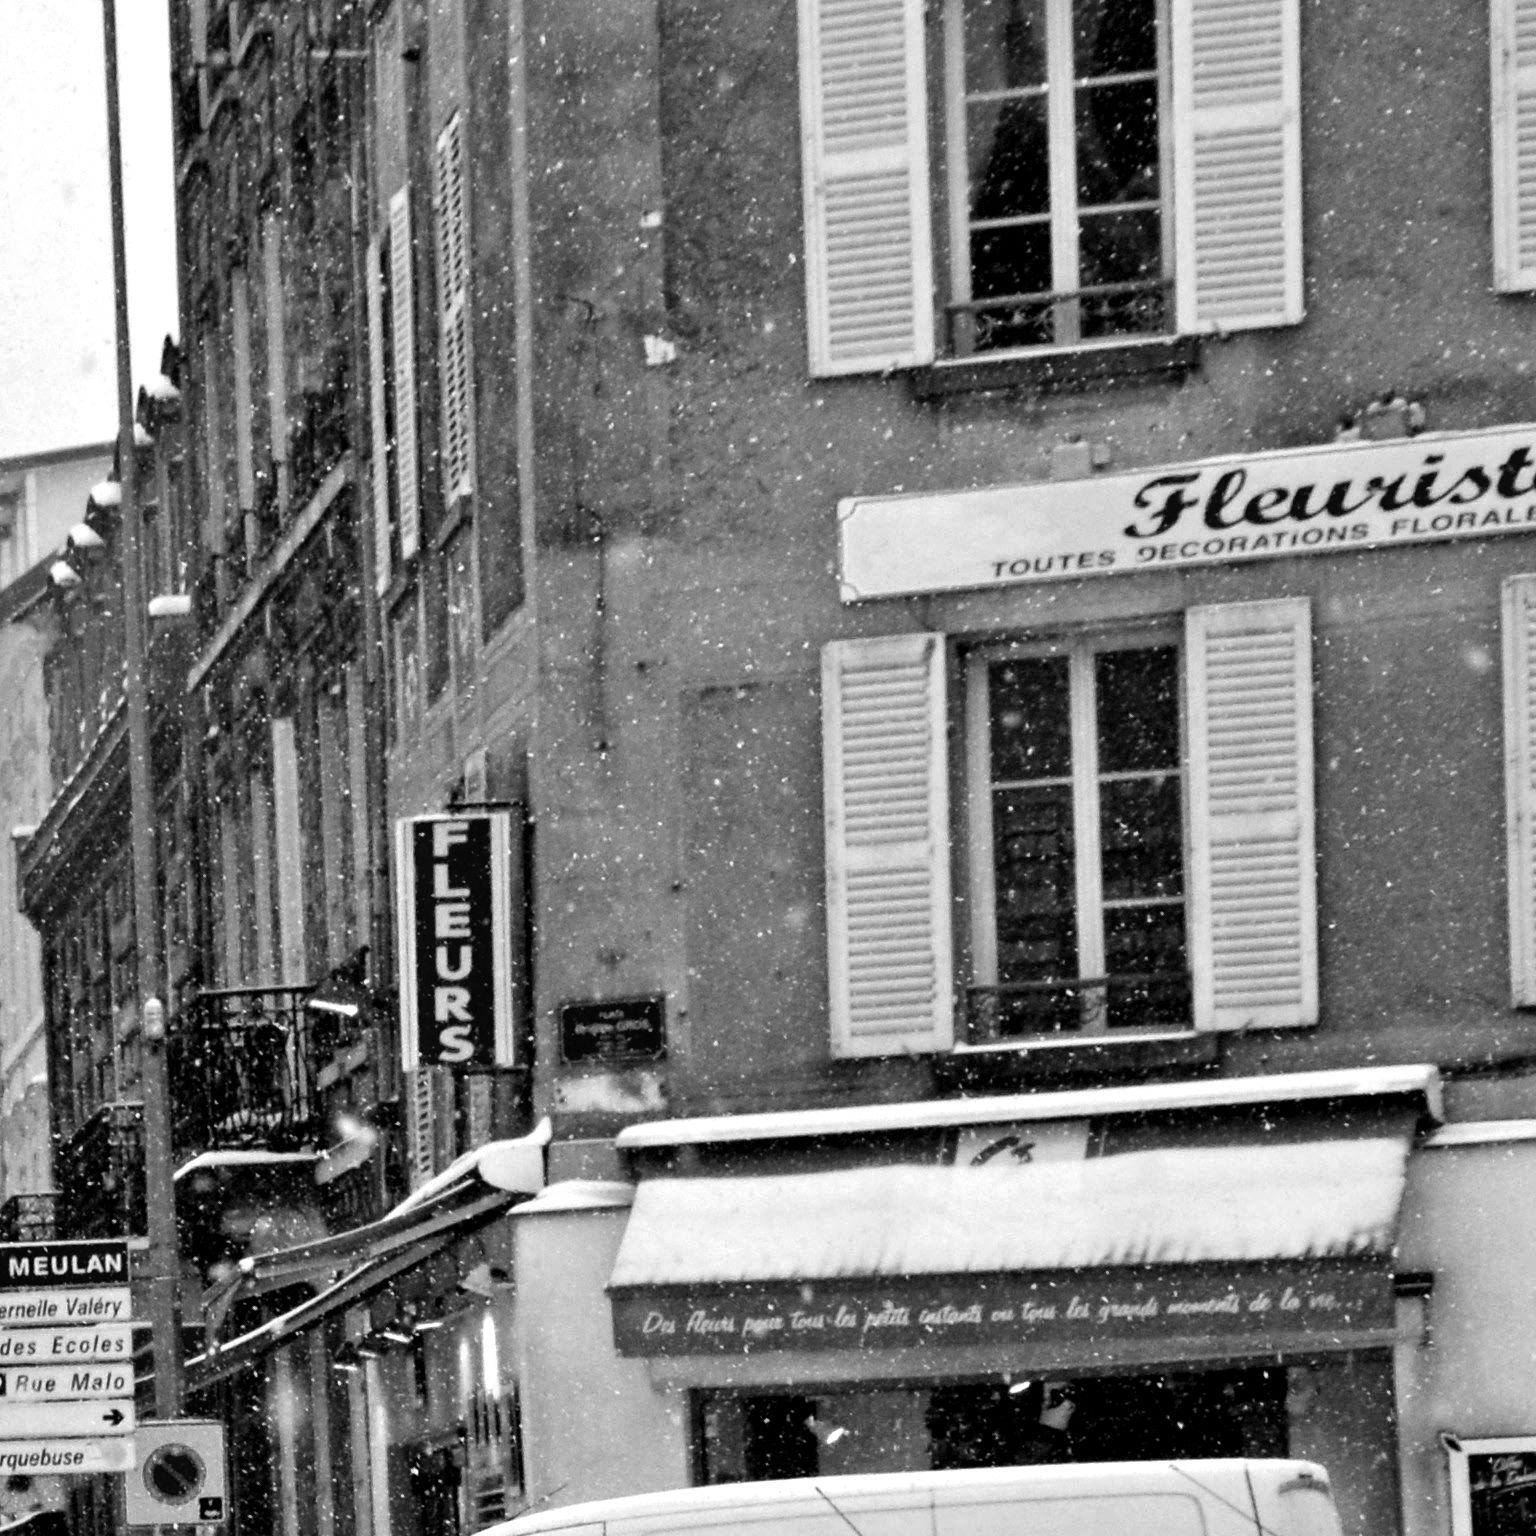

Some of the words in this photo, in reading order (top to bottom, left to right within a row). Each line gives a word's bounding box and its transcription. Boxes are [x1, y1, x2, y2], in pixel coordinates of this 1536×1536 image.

[1122, 446, 1536, 539] Fleurist
[991, 549, 1116, 579] TOUTES
[1138, 522, 1370, 563] DECORATIONS
[432, 821, 475, 1062] FLEURS
[8, 1253, 123, 1277] MEULAN
[66, 1297, 123, 1321] Valéry
[643, 1312, 675, 1334] Des
[790, 1311, 825, 1330] tous
[834, 1305, 857, 1328] les
[1066, 1296, 1089, 1319] les
[0, 1337, 37, 1357] des
[52, 1335, 124, 1356] Ecoles
[15, 1375, 57, 1393] Rue
[71, 1372, 125, 1391] Malo
